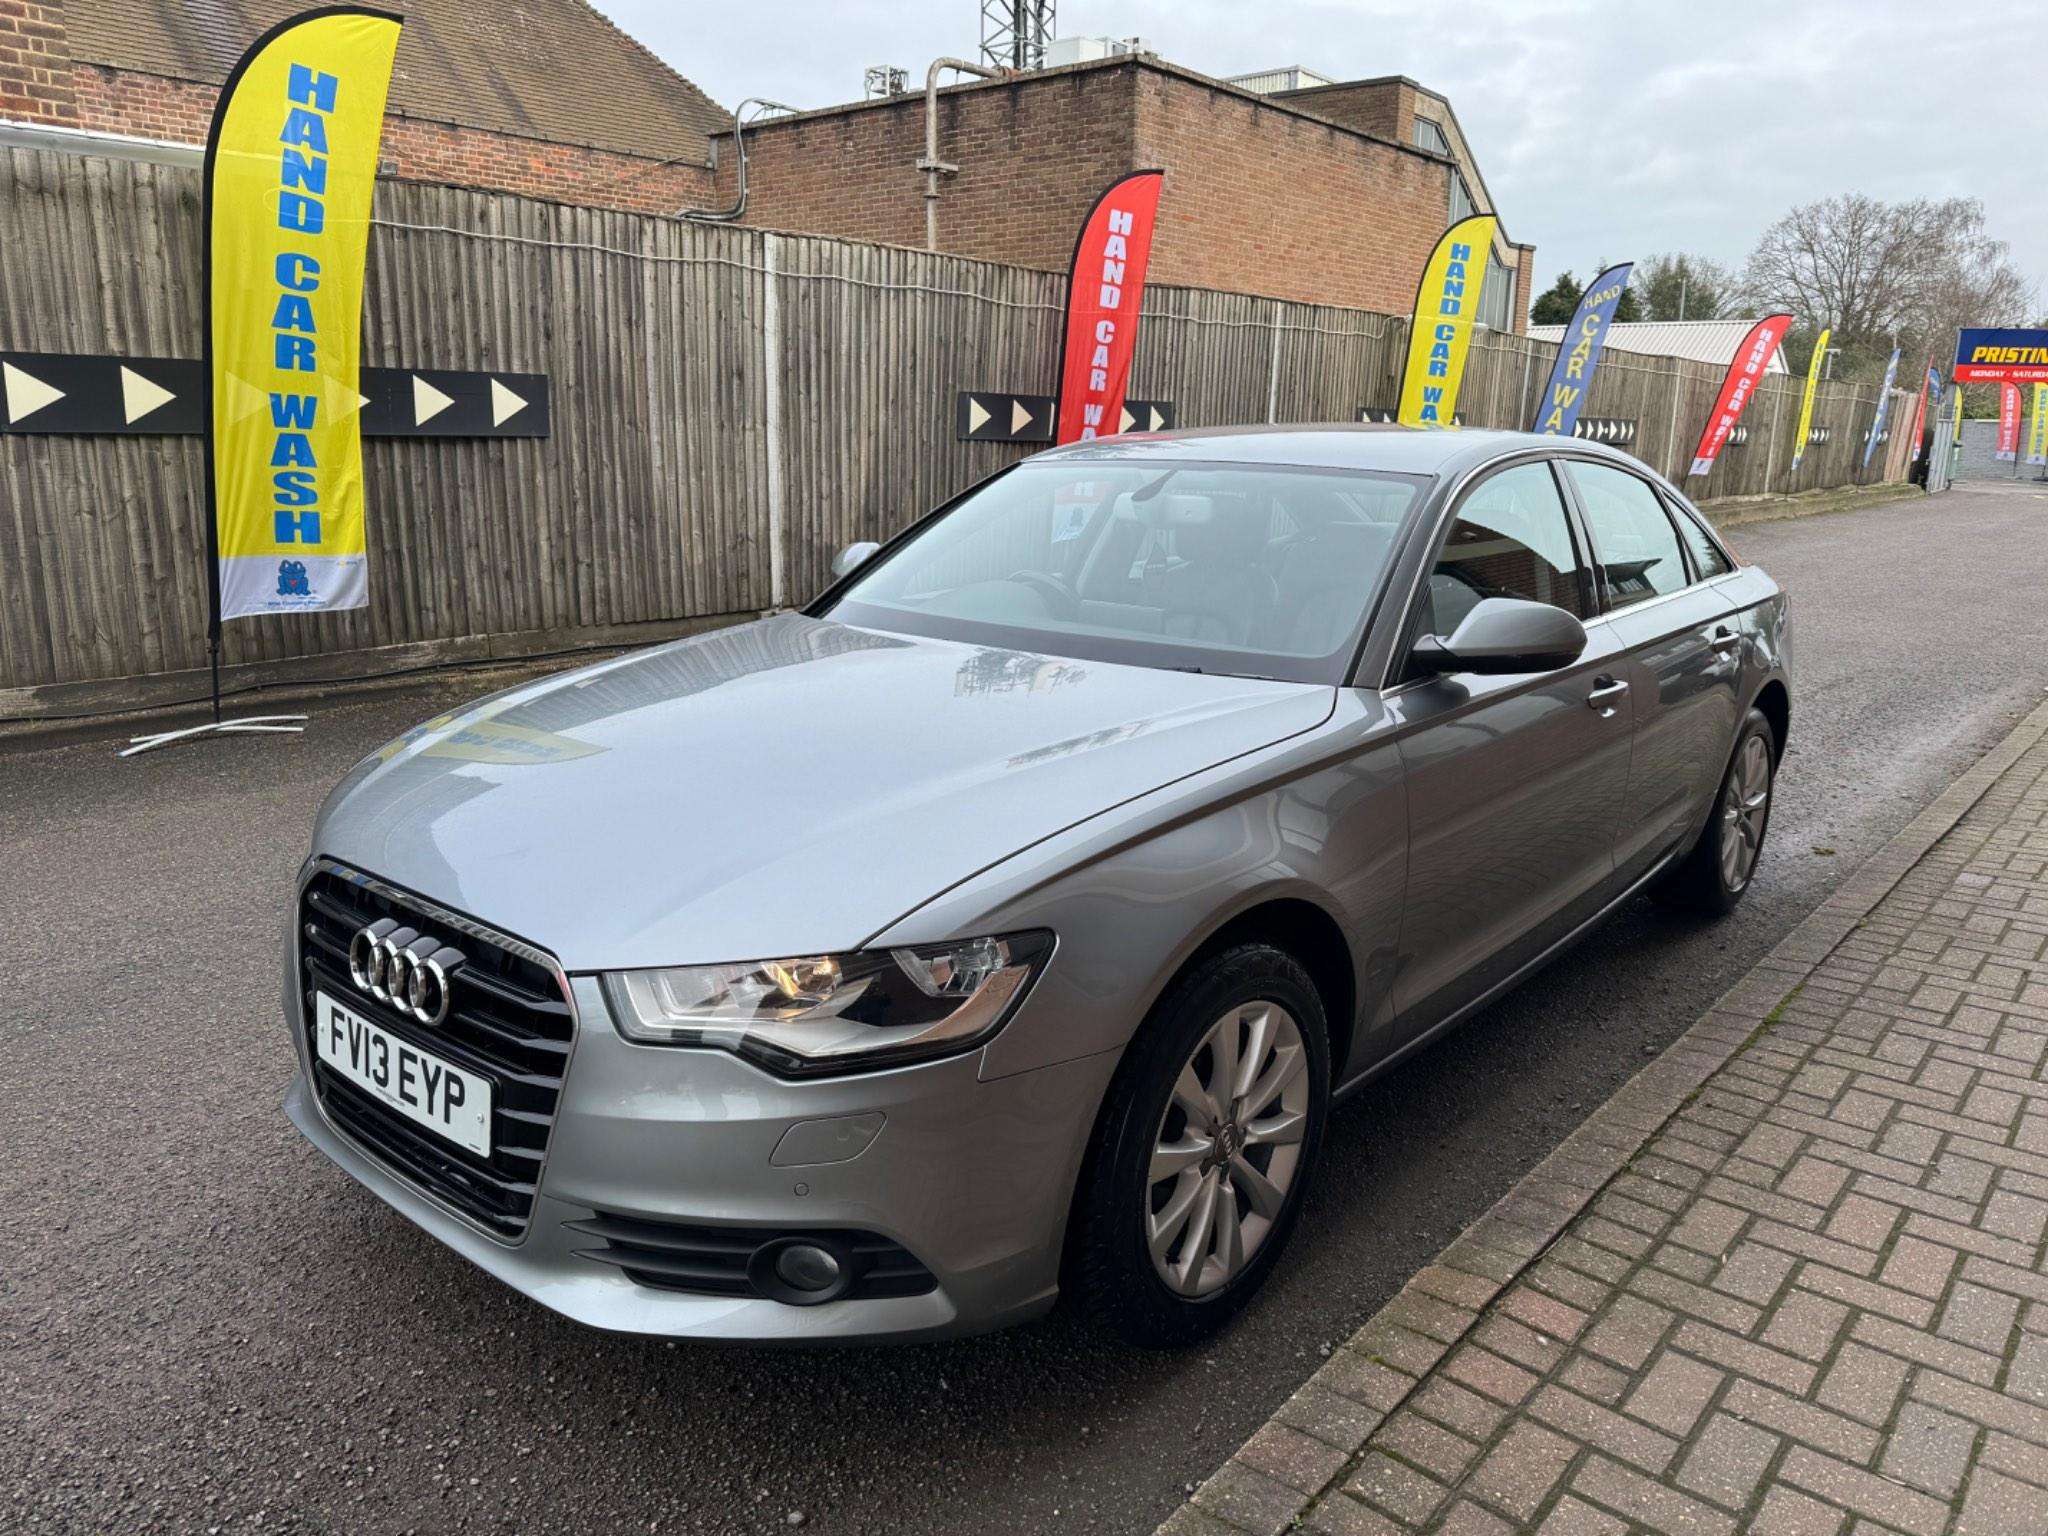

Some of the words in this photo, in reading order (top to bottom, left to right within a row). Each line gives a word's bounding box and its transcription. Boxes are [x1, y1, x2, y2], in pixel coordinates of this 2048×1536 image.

[278, 63, 338, 235] HAND
[1100, 209, 1133, 310] HAND
[1439, 243, 1471, 315] HAND
[271, 253, 321, 372] CAR
[1583, 284, 1620, 309] HAND
[1089, 320, 1115, 392] CAR
[1428, 324, 1456, 377] CAR
[1566, 314, 1601, 380] CAR
[1969, 369, 2006, 377] MONDAY
[1544, 383, 1580, 438] WA
[269, 393, 321, 544] WASH
[331, 1005, 389, 1088] FV13
[399, 1046, 465, 1124] EYP
